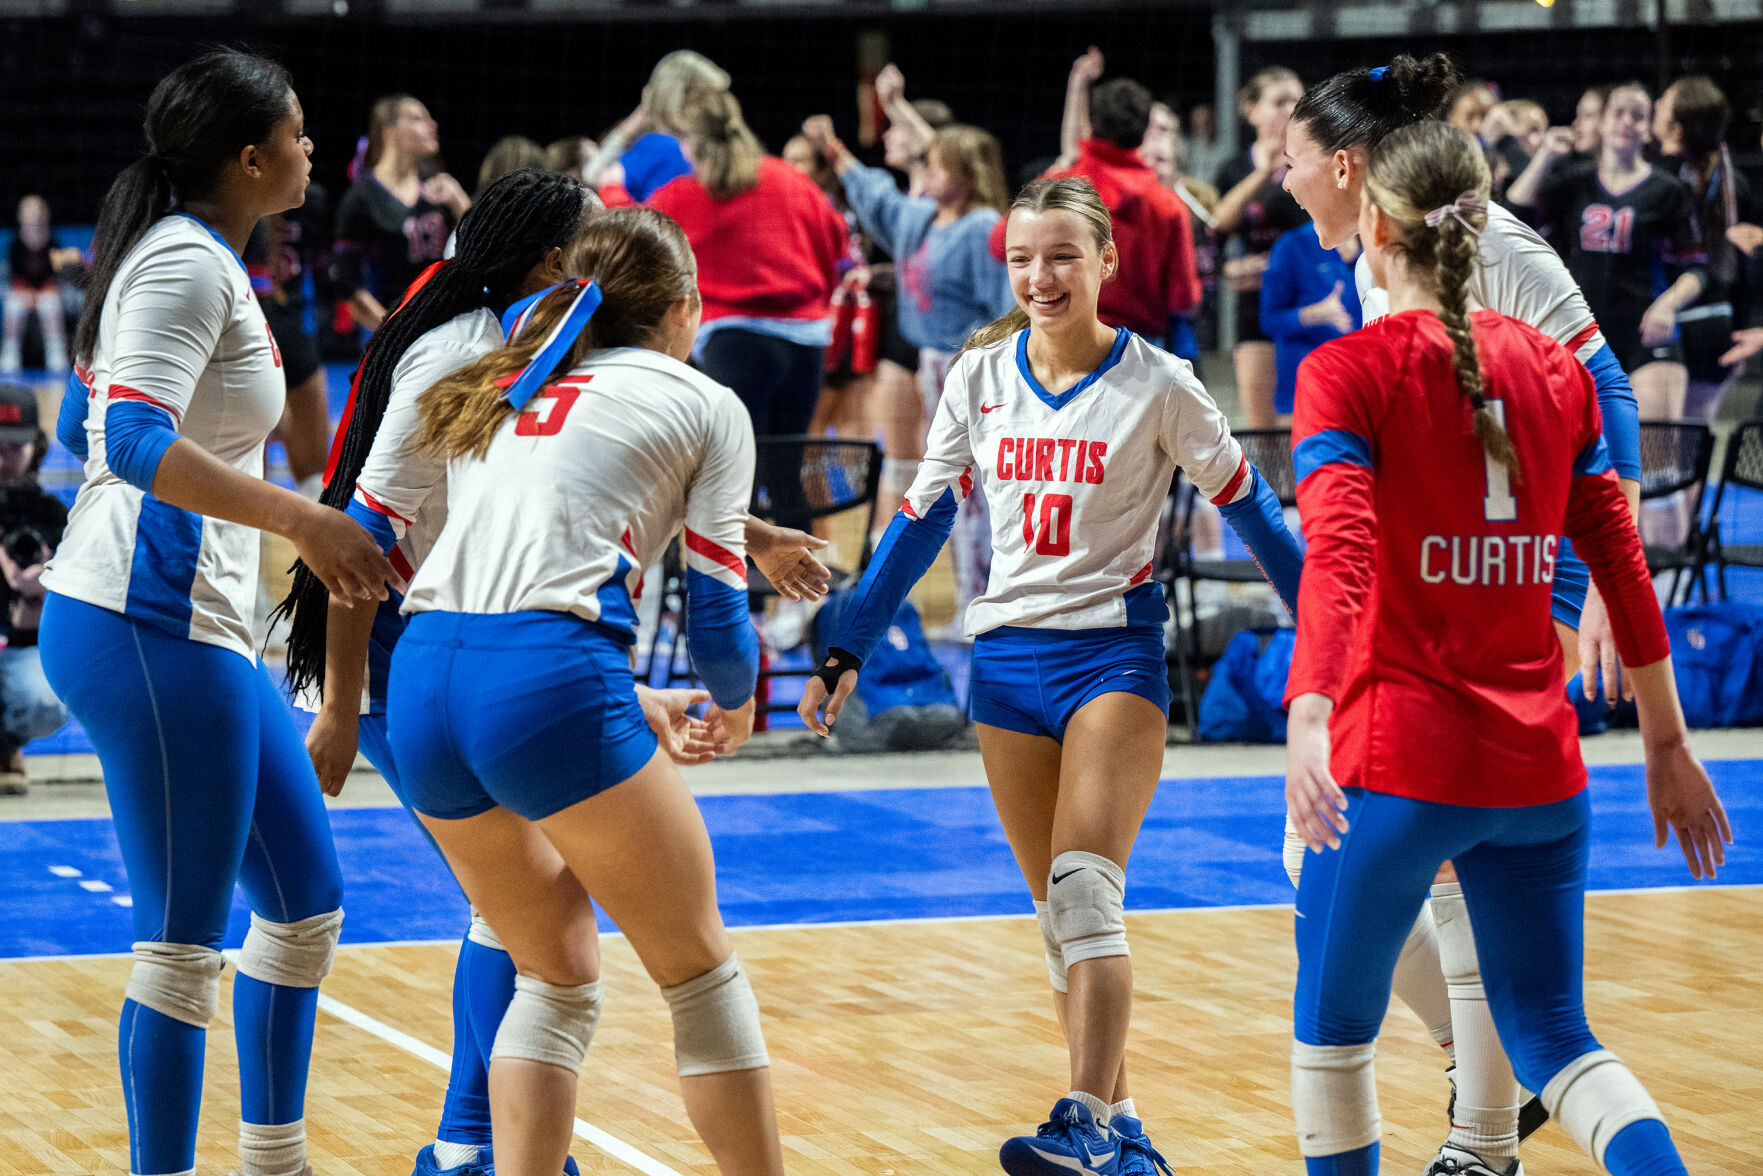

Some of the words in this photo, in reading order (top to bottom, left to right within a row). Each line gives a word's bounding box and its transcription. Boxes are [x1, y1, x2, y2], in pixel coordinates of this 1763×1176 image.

[1580, 203, 1634, 253] 21
[514, 374, 595, 436] 5
[996, 437, 1108, 484] CURTIS
[1482, 398, 1518, 521] 1
[1022, 493, 1073, 557] 10
[1420, 533, 1556, 586] CURTIS
